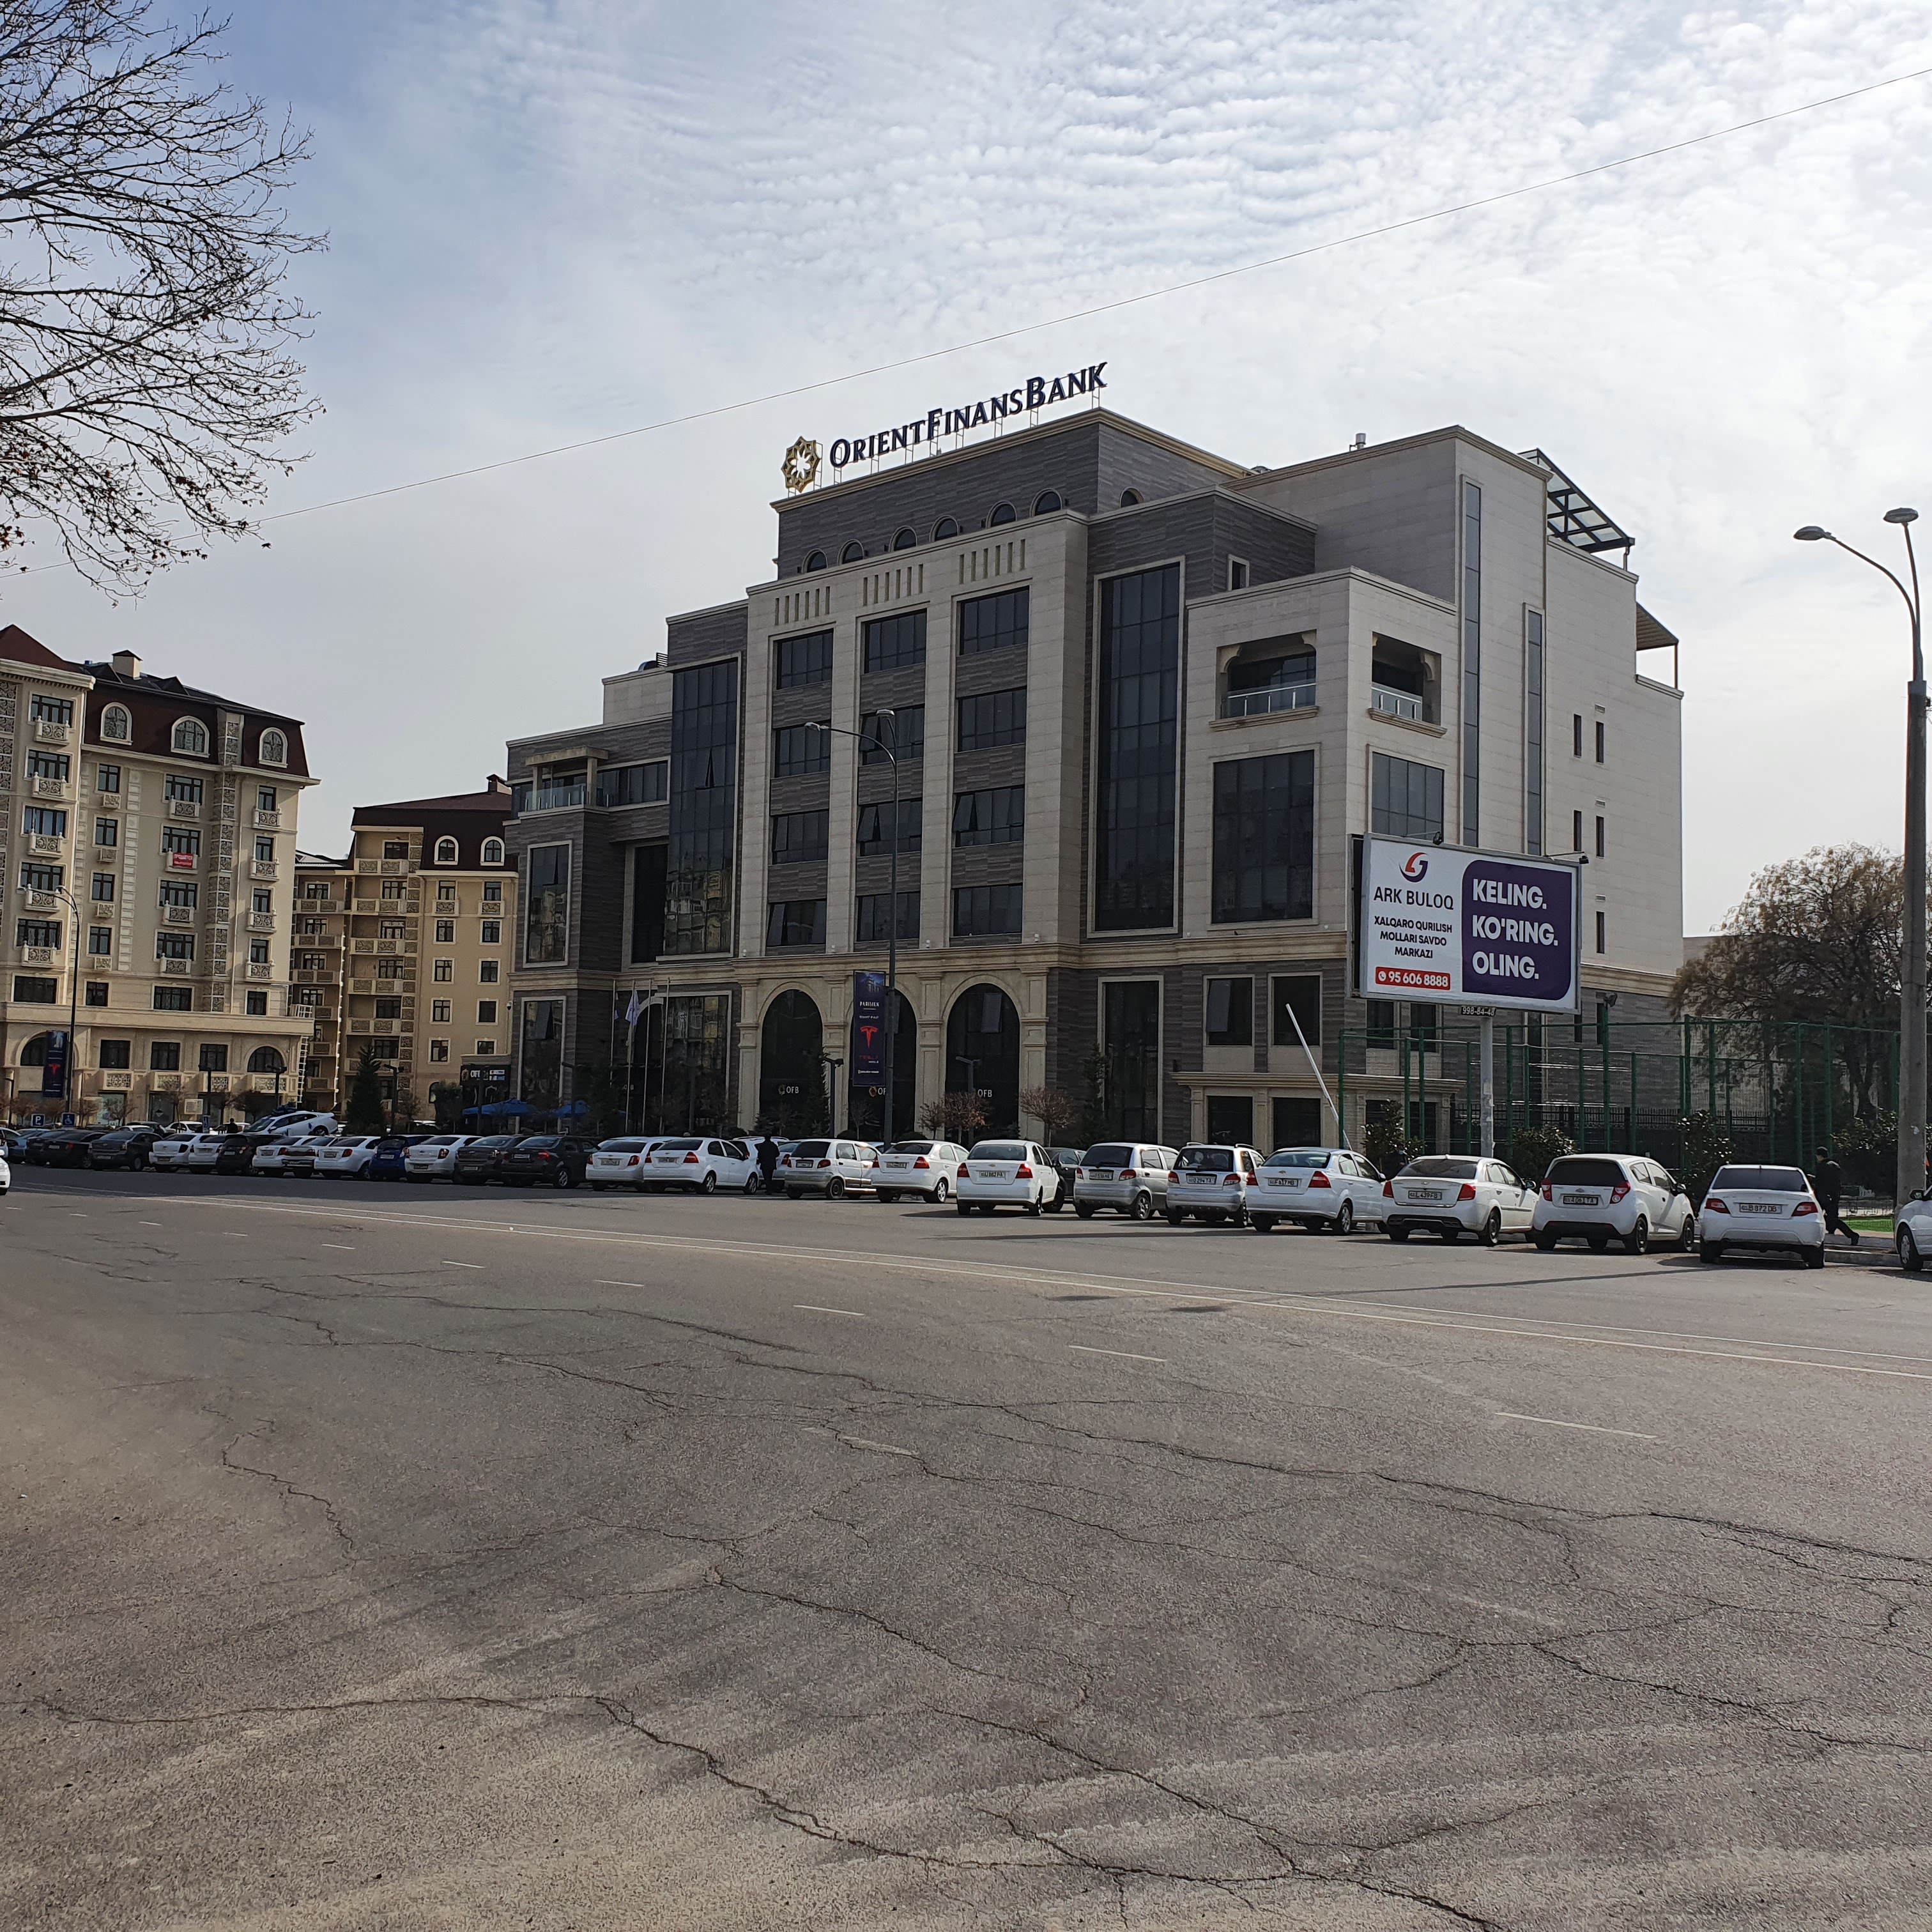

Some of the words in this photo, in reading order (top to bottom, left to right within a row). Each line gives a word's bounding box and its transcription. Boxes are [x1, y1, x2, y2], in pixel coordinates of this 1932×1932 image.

[1374, 886, 1402, 904] ARK
[1406, 890, 1453, 910] BULOQ
[1473, 878, 1547, 909] KELING.
[1374, 916, 1414, 928] XALQARO
[1415, 921, 1452, 933] QURILISH
[1472, 914, 1558, 946] KO'RING.
[1380, 931, 1417, 943] MOLLARI
[1418, 935, 1447, 946] SAVDO
[1395, 946, 1433, 958] MARKAZI
[1472, 951, 1539, 979] OLING.
[1388, 971, 1401, 983] 95
[1402, 972, 1422, 985] 606
[1423, 974, 1448, 987] 8888
[1462, 1006, 1496, 1016] 998-84-48
[977, 1089, 992, 1098] OFB
